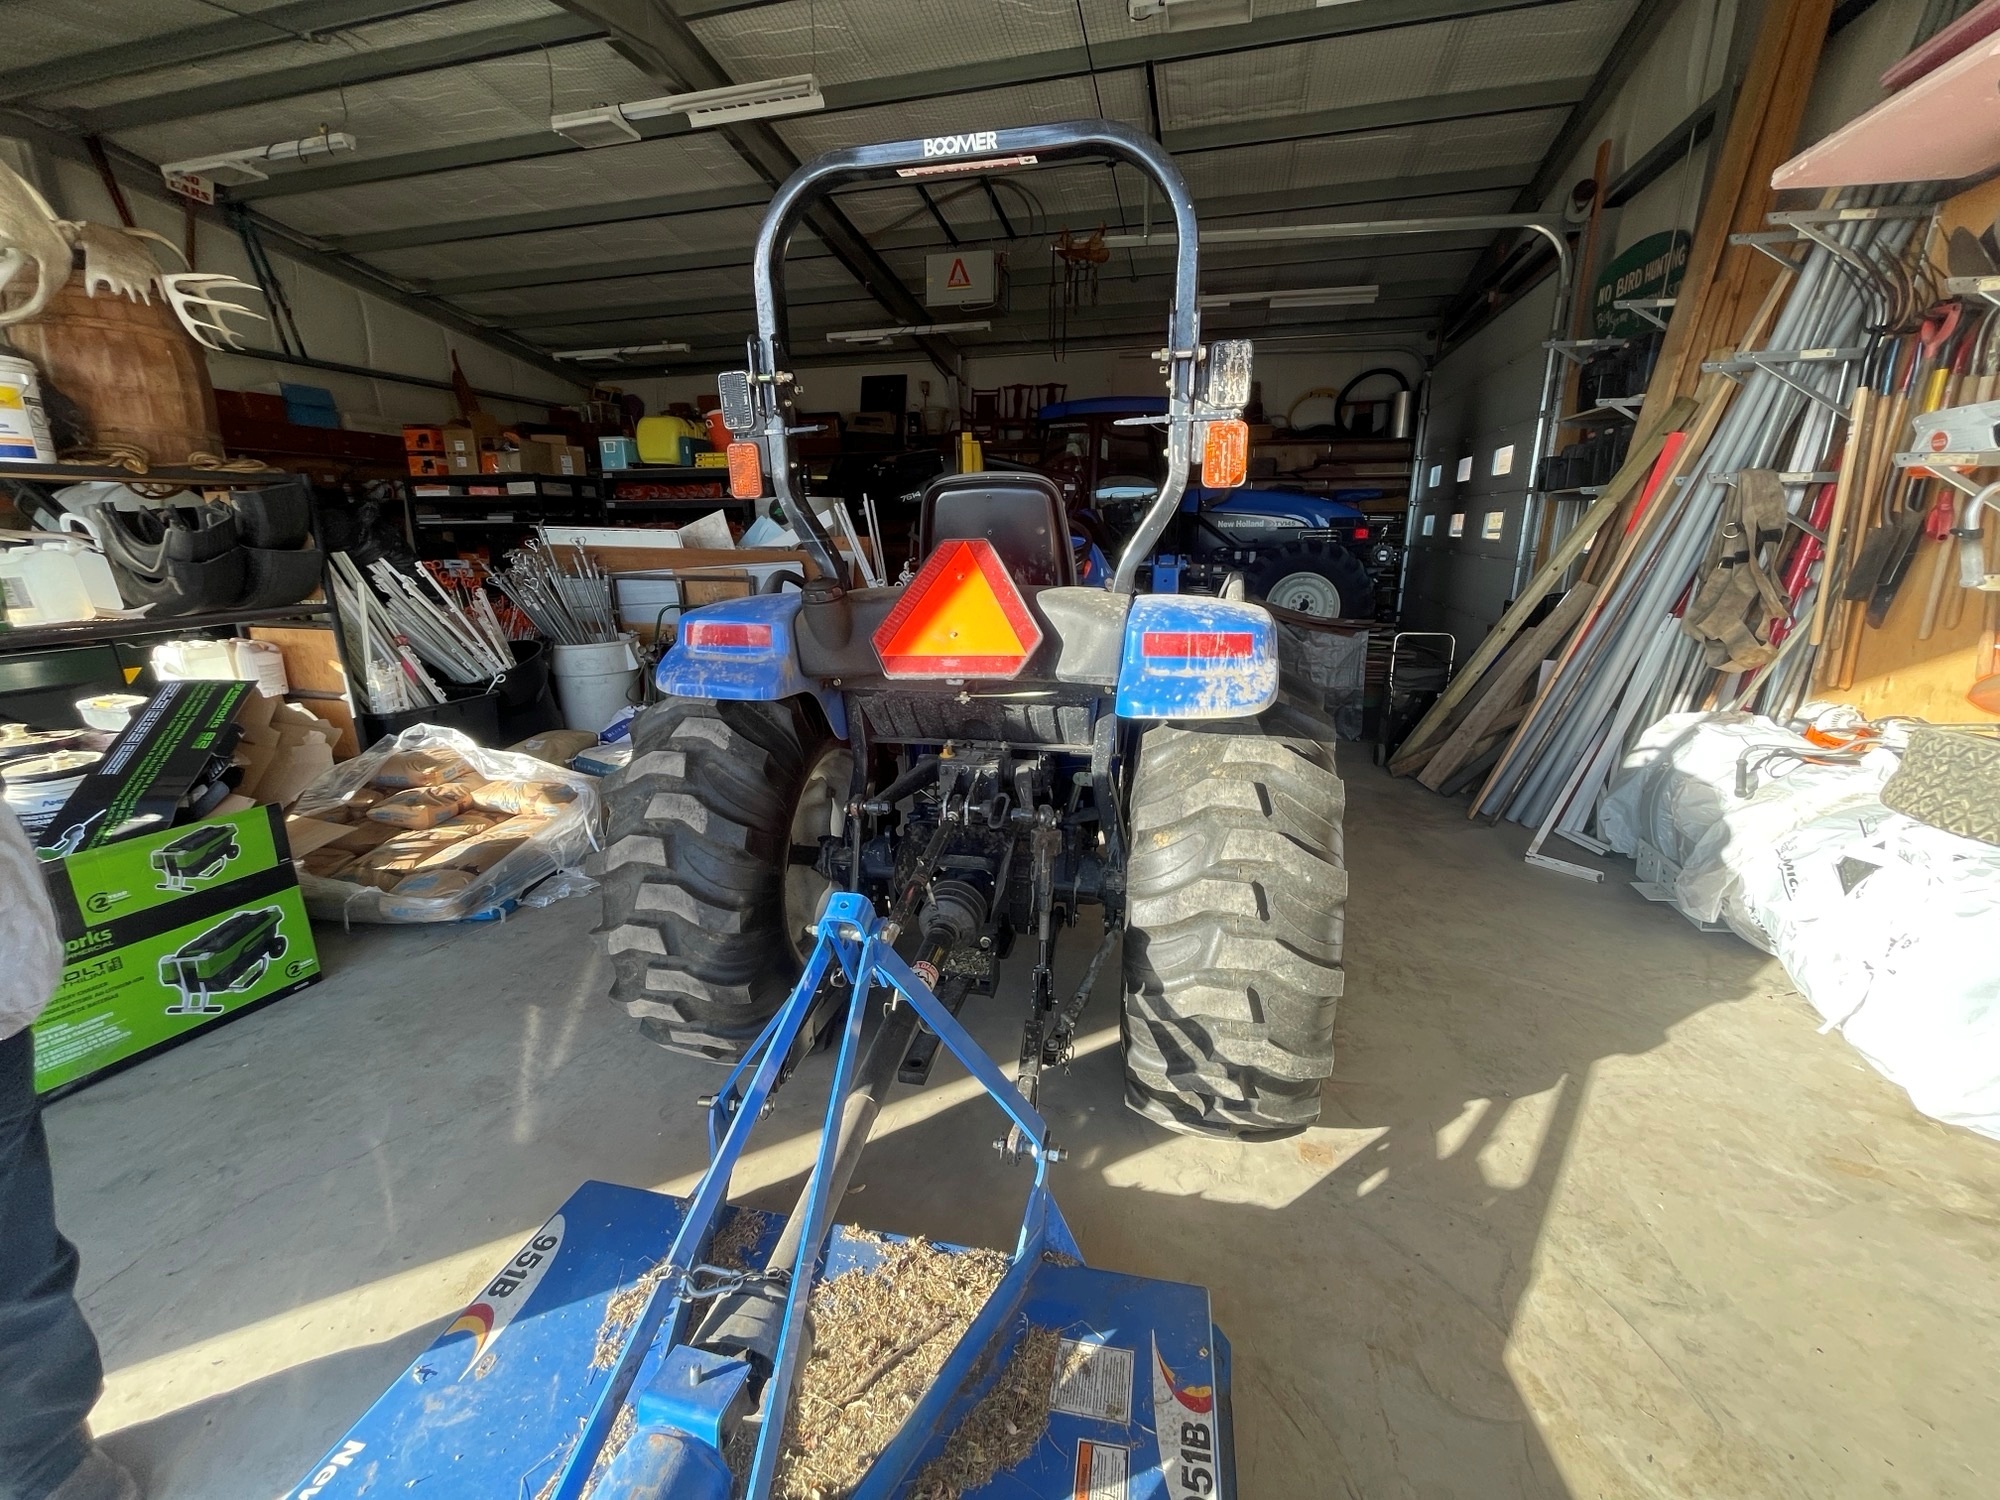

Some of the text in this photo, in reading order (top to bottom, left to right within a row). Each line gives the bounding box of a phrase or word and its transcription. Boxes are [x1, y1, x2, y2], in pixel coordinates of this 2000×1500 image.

[923, 131, 998, 158] BOOMER
[170, 180, 210, 201] CARS
[1597, 284, 1612, 307] NO
[1616, 268, 1643, 298] BIRD
[1644, 244, 1686, 284] HUNTING
[899, 490, 922, 503] 7614
[1217, 519, 1265, 528] New Holland
[65, 928, 112, 952] orks
[63, 960, 108, 983] OLT
[487, 1234, 558, 1299] 951B
